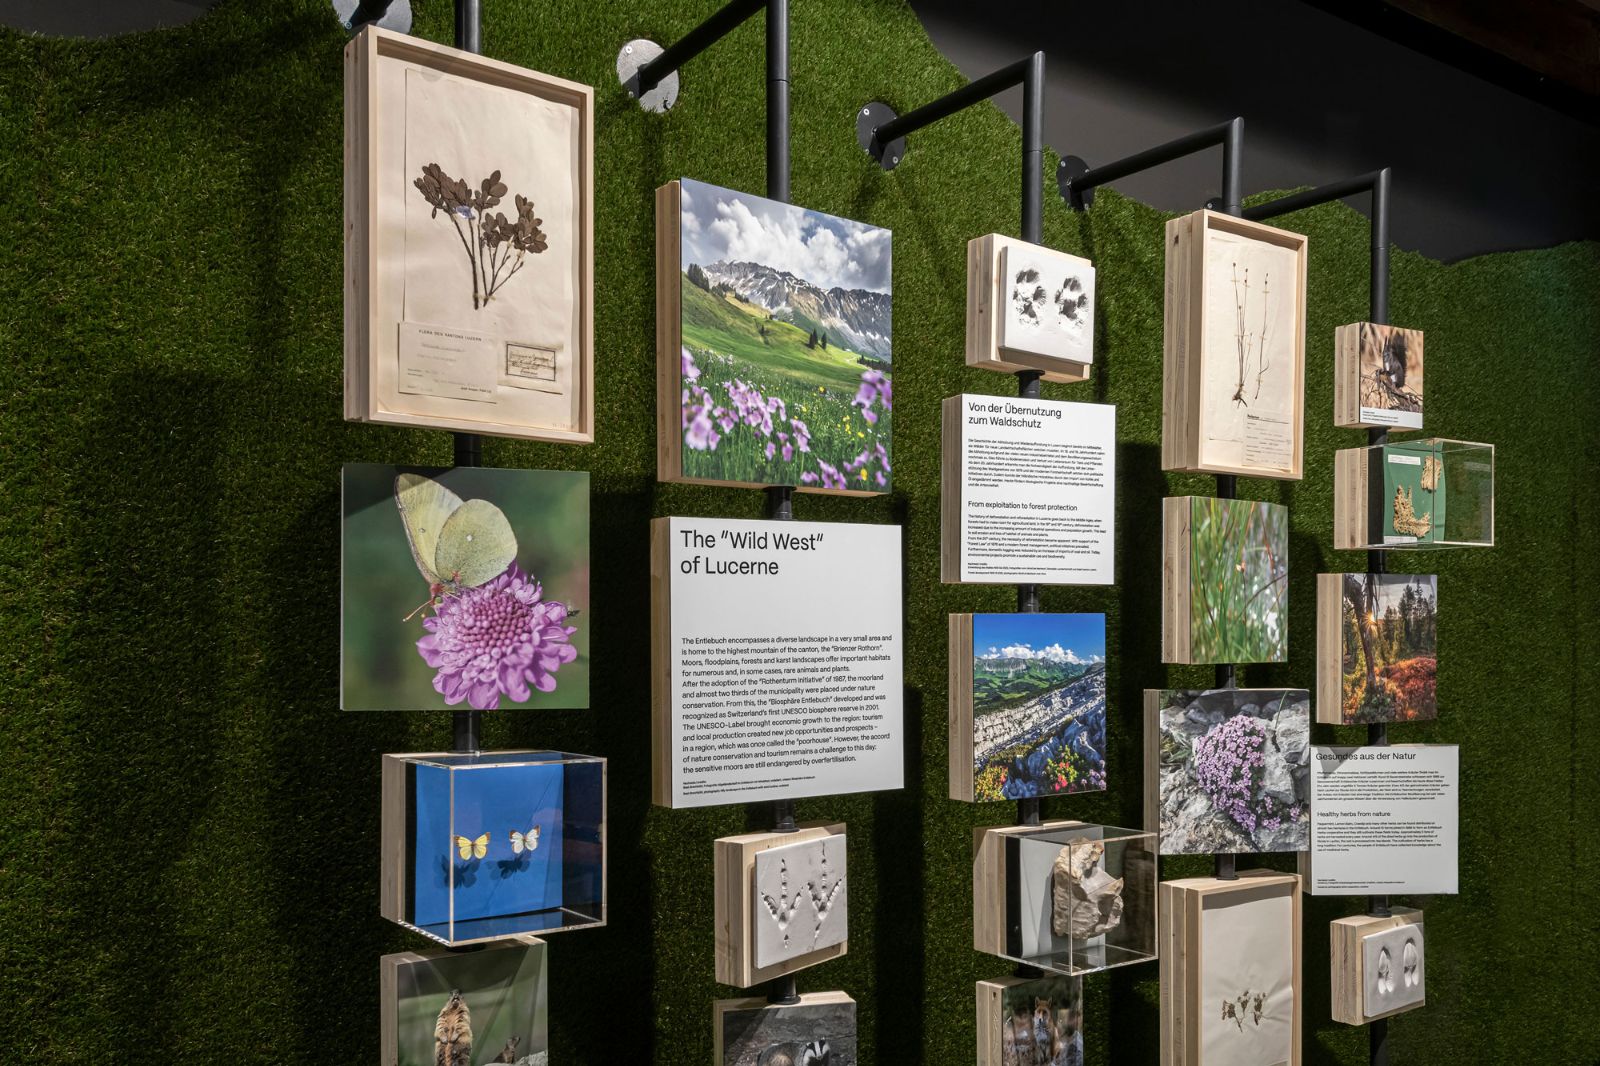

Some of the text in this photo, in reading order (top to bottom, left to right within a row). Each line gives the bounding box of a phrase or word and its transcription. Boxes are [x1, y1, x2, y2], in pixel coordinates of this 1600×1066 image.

[969, 402, 1062, 419] Von der Übernutzung
[990, 417, 1041, 428] Waldschutz
[986, 502, 1020, 510] exploitation
[680, 530, 716, 548] The
[680, 556, 779, 575] of Lucerne
[681, 659, 703, 667] Moors,
[704, 658, 740, 666] floodplains,
[792, 656, 824, 664] landscapes
[711, 679, 739, 688] adoption
[768, 687, 804, 696] municipality
[743, 699, 756, 707] this,
[832, 695, 862, 703] developed
[682, 712, 717, 721] recognized
[808, 706, 836, 715] biosphere
[746, 720, 770, 728] brought
[801, 717, 822, 725] growth
[712, 731, 746, 740] production
[794, 726, 833, 736] opportunities
[845, 724, 873, 733] prospects
[695, 743, 716, 752] region,
[833, 735, 859, 743] However,
[712, 752, 753, 760] conservation
[818, 745, 846, 754] challenge
[766, 758, 802, 768] endangered
